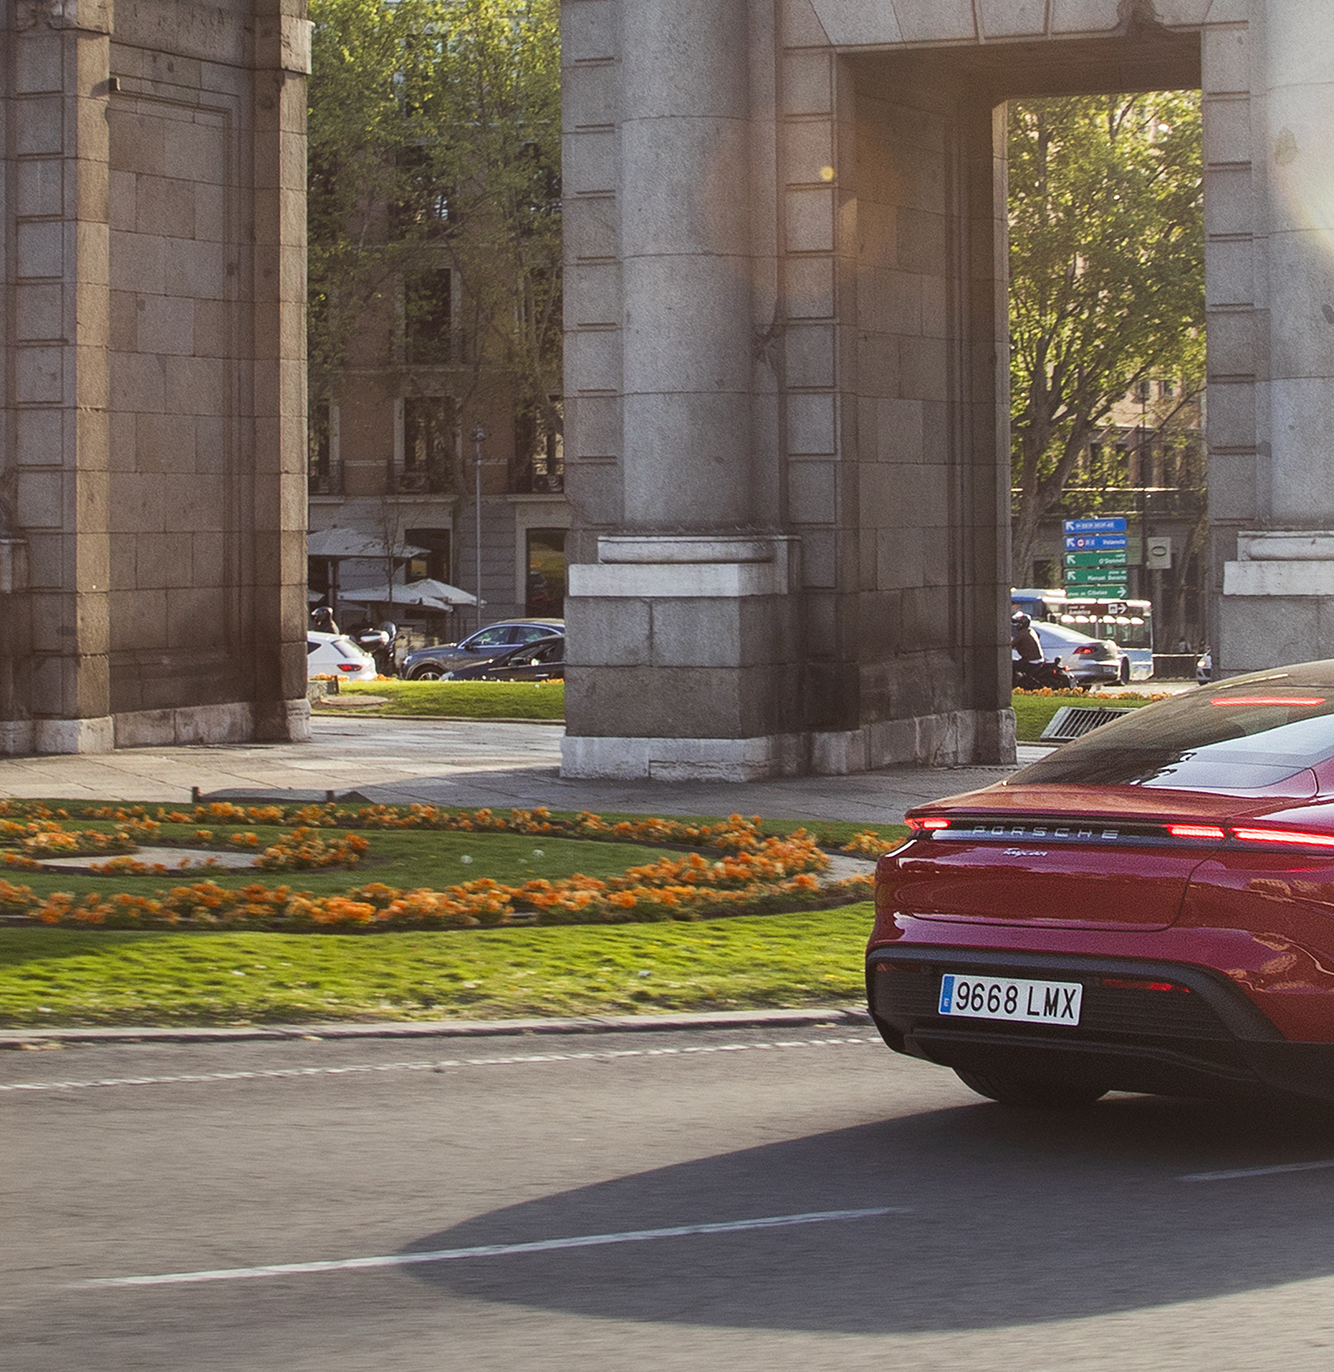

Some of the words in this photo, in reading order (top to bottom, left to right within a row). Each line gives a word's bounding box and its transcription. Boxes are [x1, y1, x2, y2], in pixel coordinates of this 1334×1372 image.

[972, 825, 1120, 840] PORSCHE
[955, 981, 1019, 1015] 9668
[1026, 985, 1077, 1020] LMX
